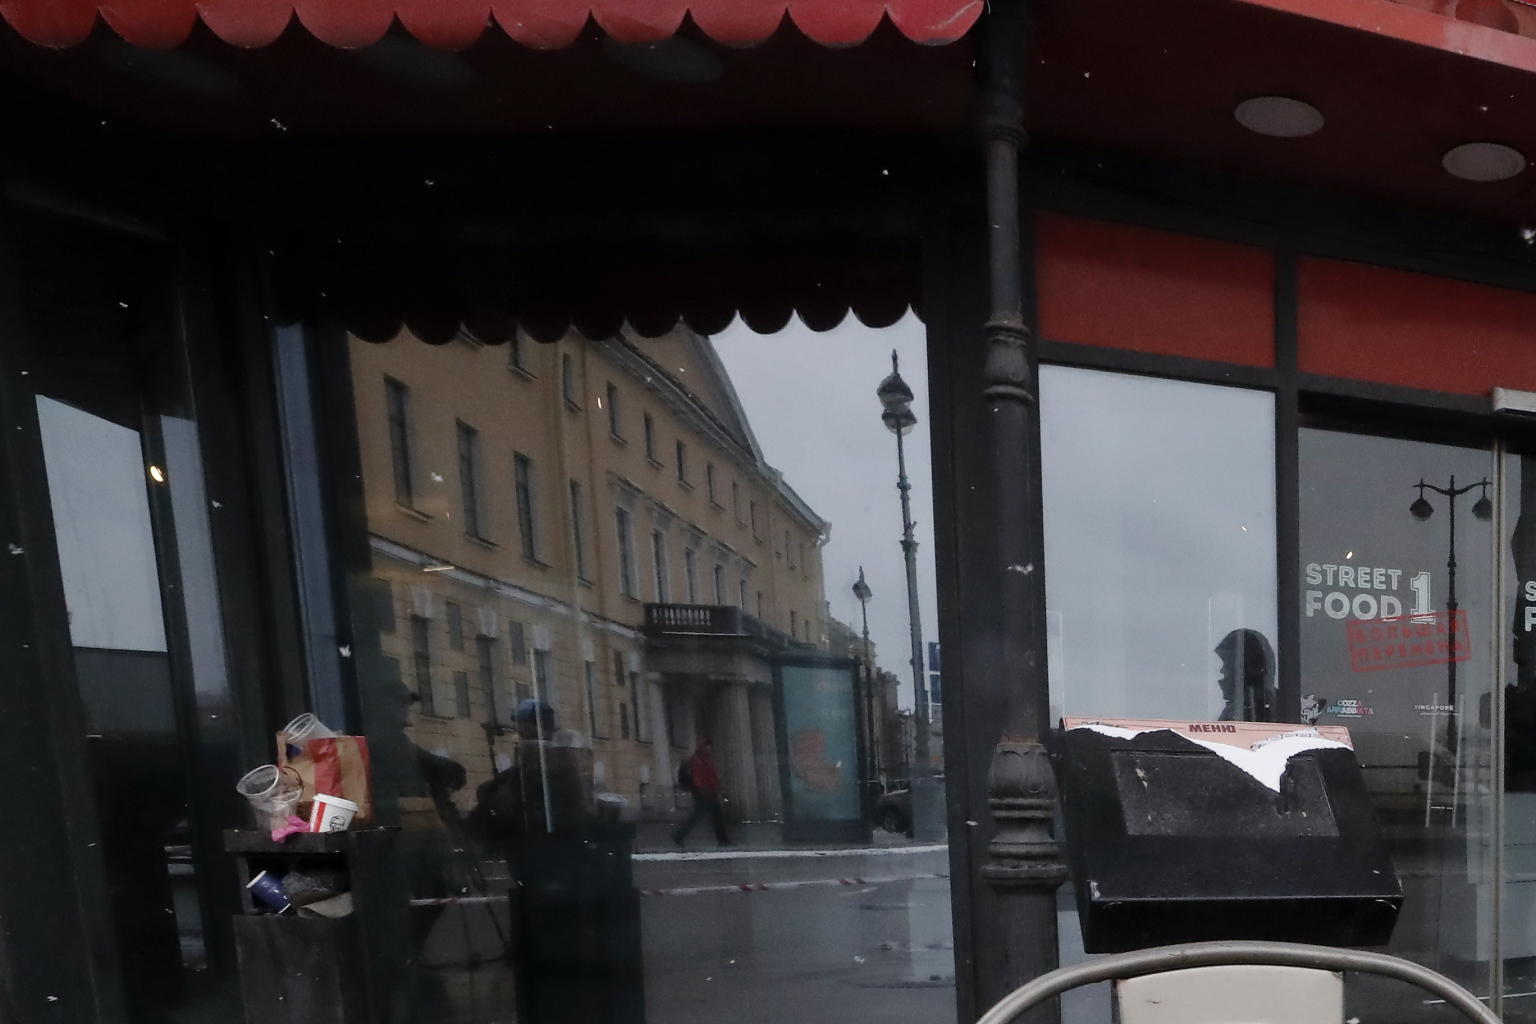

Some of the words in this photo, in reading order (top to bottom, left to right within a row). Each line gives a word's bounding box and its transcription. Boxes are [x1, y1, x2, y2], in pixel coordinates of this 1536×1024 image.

[1305, 563, 1402, 590] STREET
[1305, 590, 1403, 622] FOOD
[1409, 572, 1437, 624] 1
[1189, 723, 1236, 734] МЕНЮ
